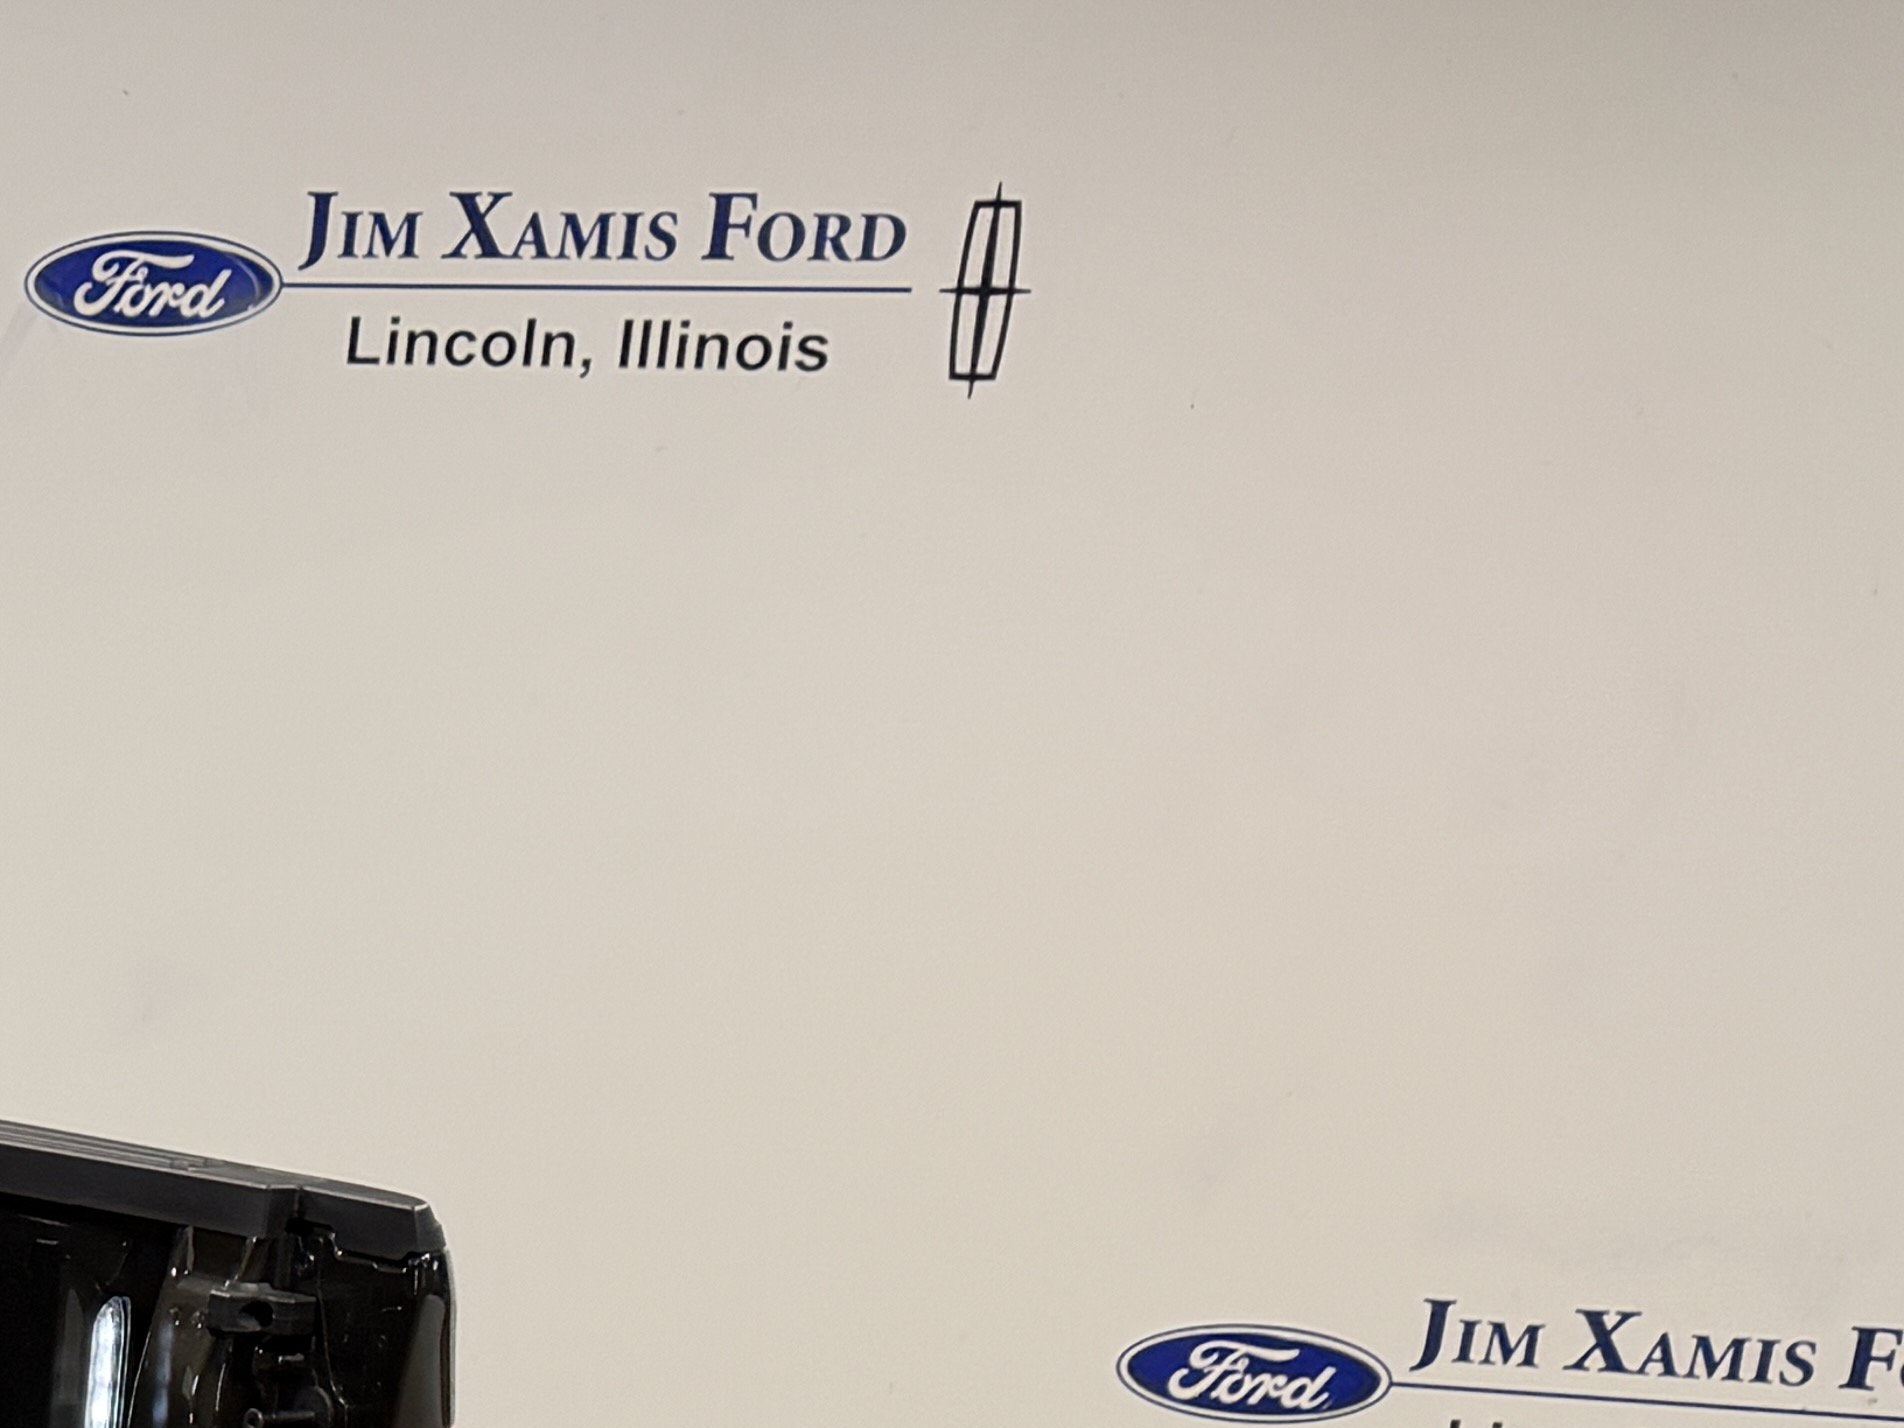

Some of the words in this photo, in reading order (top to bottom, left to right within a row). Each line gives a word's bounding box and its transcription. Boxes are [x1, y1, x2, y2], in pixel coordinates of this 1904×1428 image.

[297, 190, 424, 271] JIM
[440, 191, 678, 262] XAMIS
[700, 191, 907, 263] FORD
[73, 249, 232, 319] Ford
[346, 315, 592, 379] Lincoln,
[618, 318, 829, 374] Illinois
[1167, 1339, 1337, 1410] Ford
[1408, 1297, 1546, 1373] JIM
[1564, 1308, 1817, 1388] XAMIS
